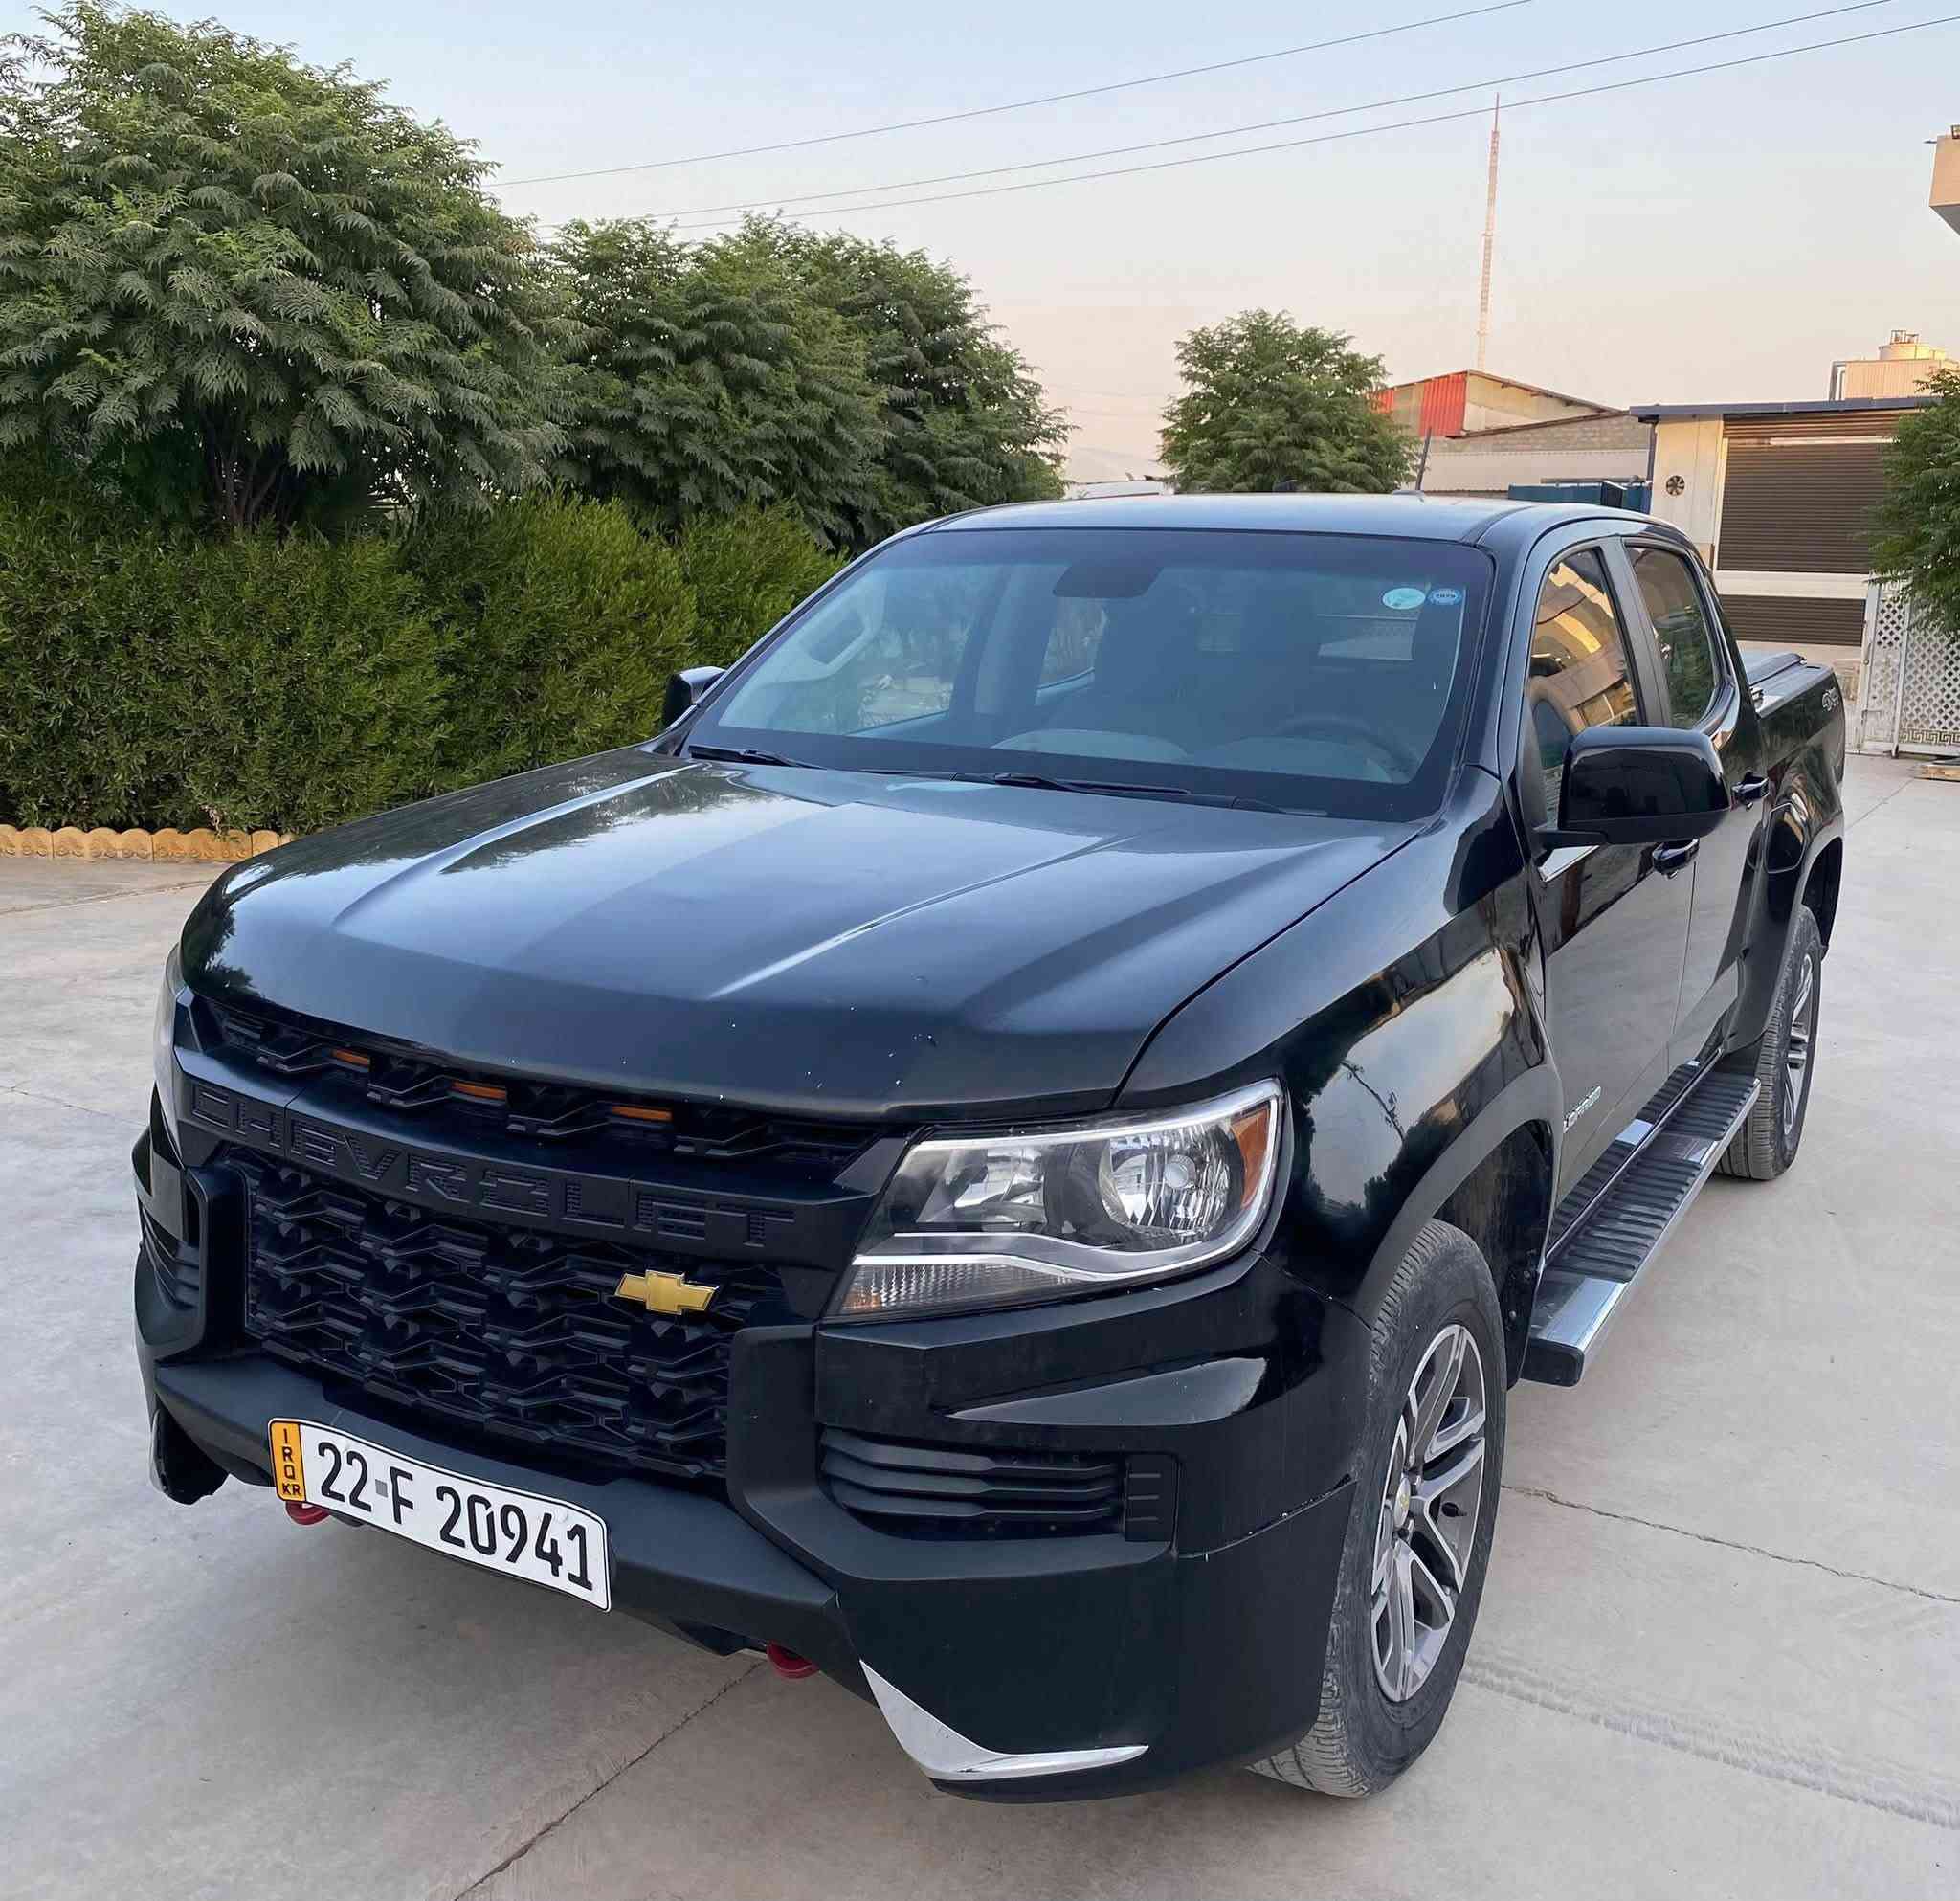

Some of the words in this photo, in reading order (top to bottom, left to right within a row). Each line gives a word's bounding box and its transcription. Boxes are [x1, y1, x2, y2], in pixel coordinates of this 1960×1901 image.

[192, 1087, 796, 1247] CHEVROLET
[281, 1483, 301, 1496] KR
[318, 1442, 372, 1512] 22
[389, 1465, 414, 1525] F
[436, 1485, 593, 1591] 20941
